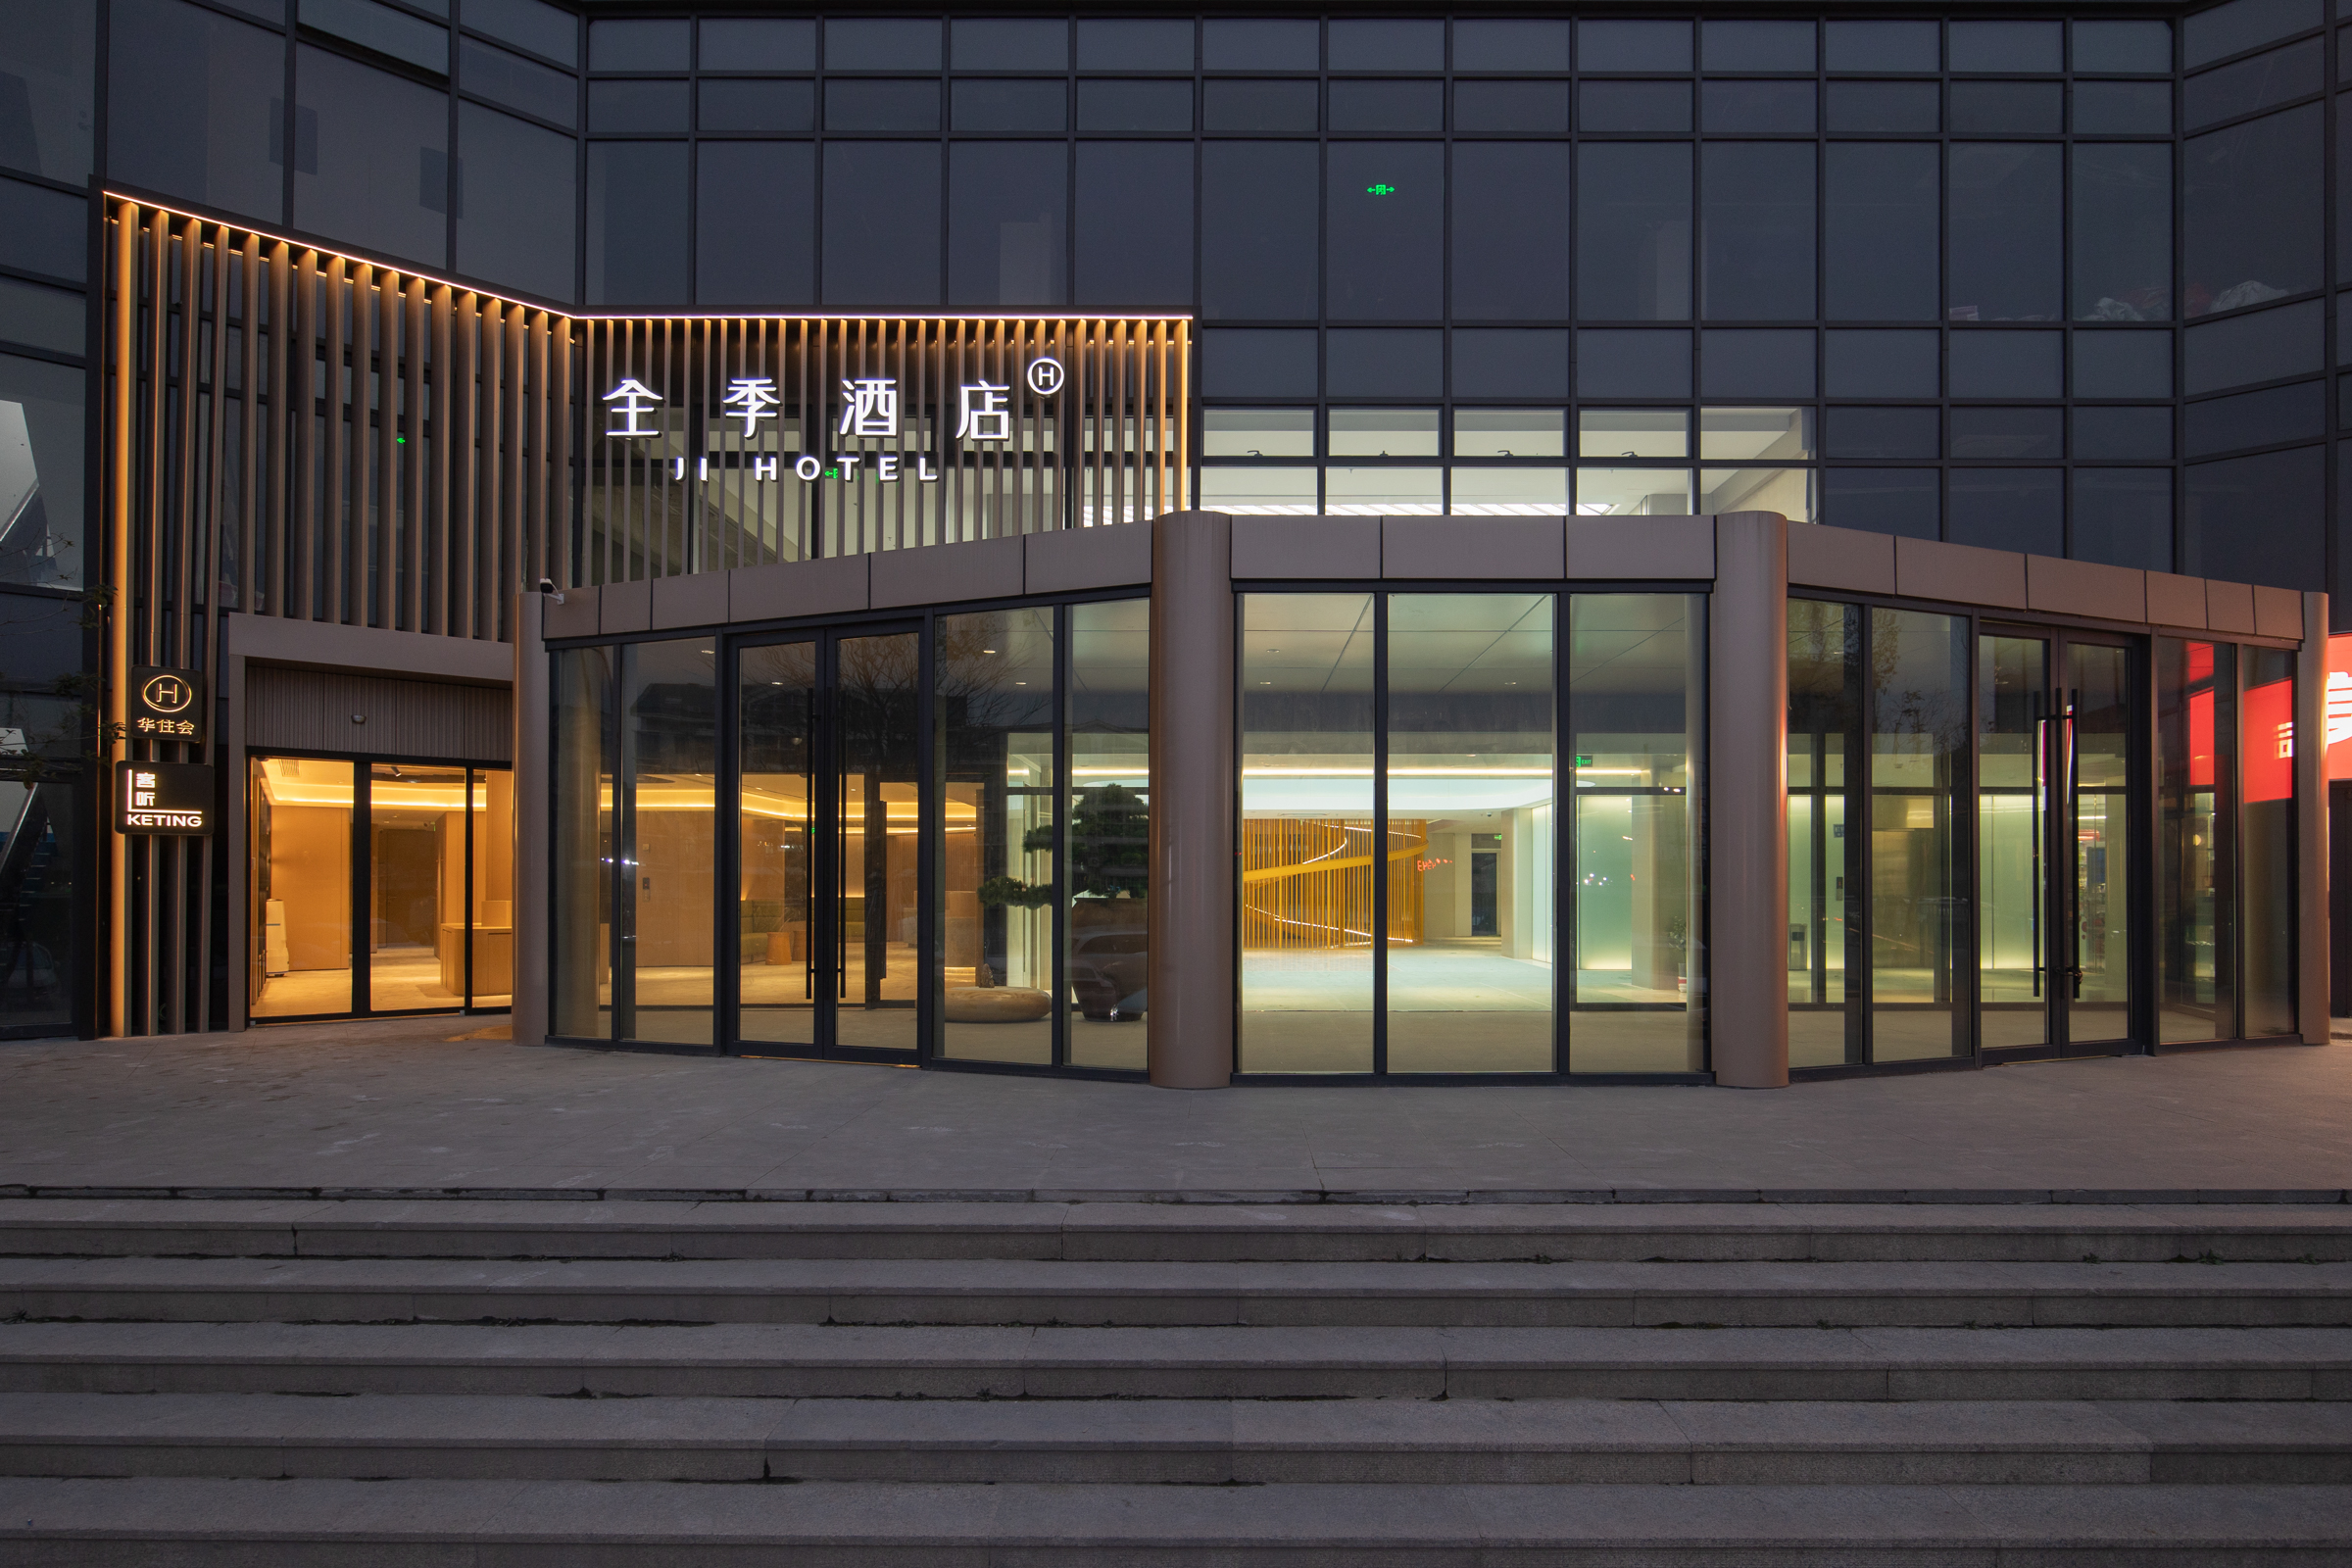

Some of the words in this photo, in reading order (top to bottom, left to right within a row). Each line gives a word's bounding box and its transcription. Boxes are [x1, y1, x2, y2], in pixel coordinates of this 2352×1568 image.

[602, 378, 1010, 440] 全季酒店
[675, 457, 708, 481] JI
[756, 457, 938, 481] HOTEL
[137, 717, 195, 735] 华住会
[126, 813, 202, 827] KETING
